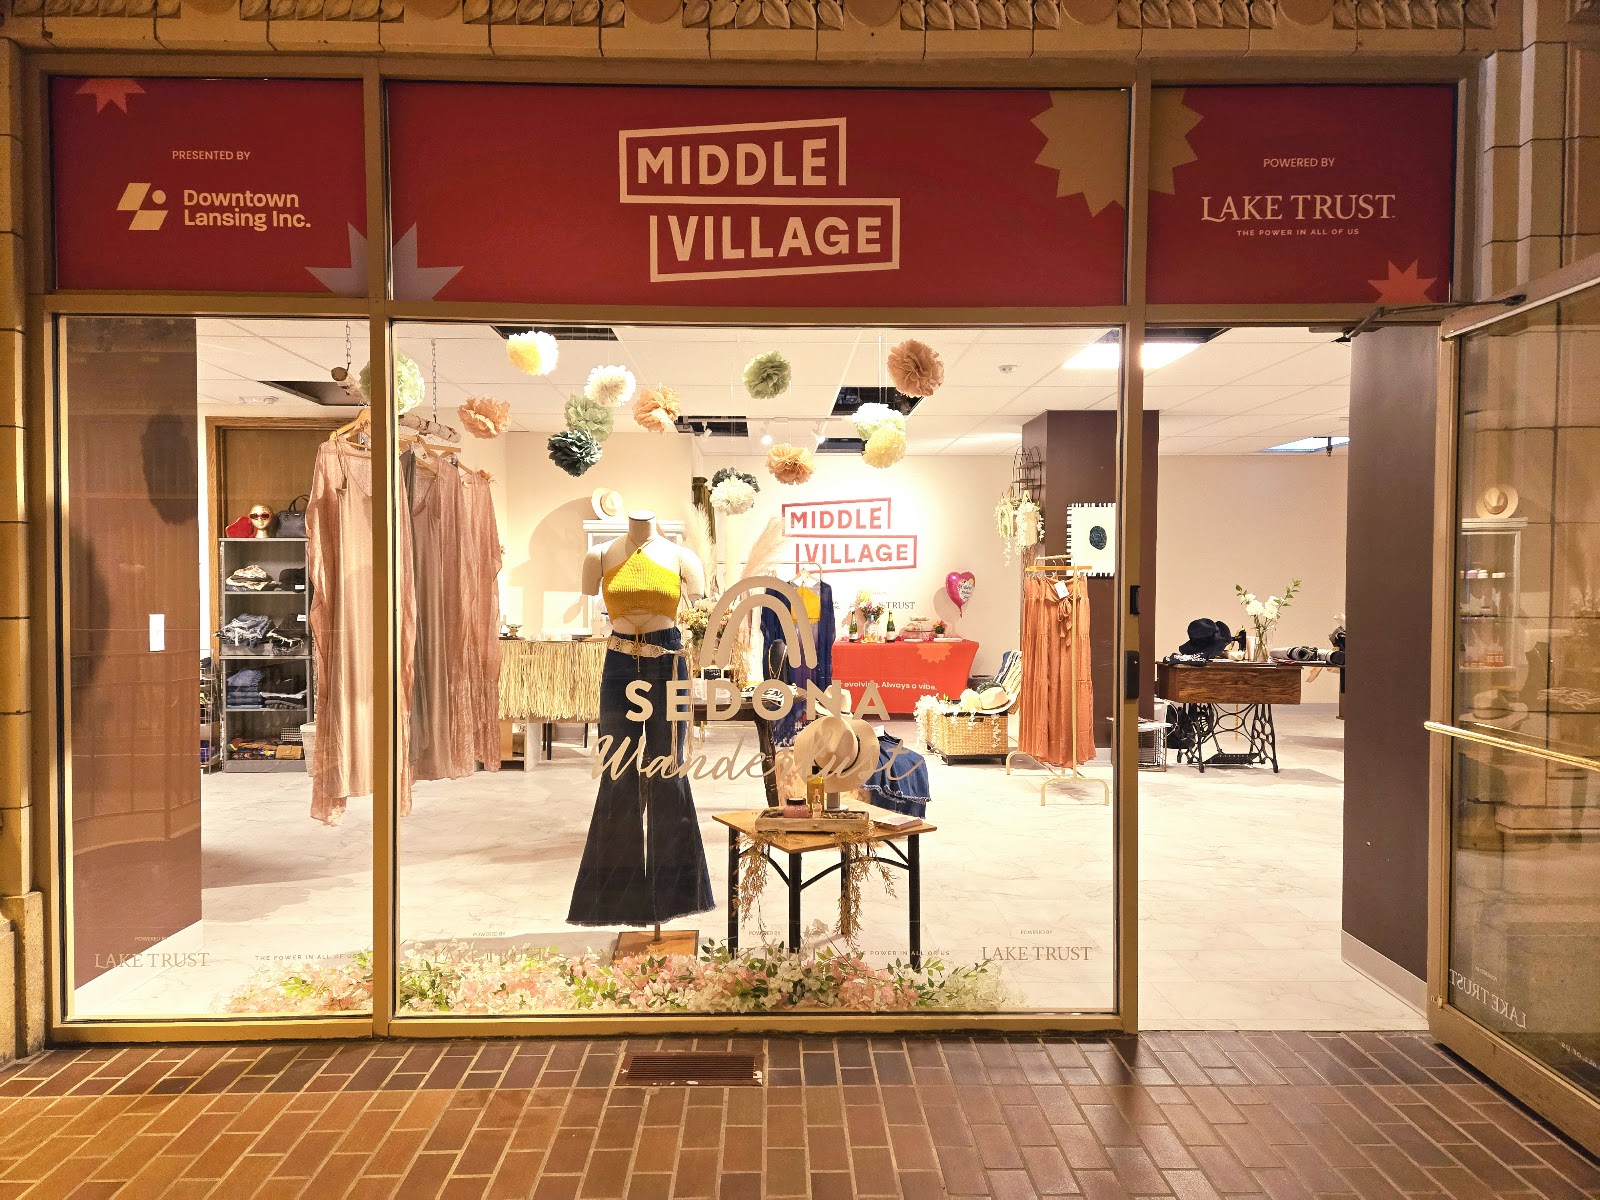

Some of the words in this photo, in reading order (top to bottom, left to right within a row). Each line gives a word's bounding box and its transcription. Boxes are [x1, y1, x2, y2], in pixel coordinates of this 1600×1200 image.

[172, 150, 234, 161] PRESENTED
[236, 150, 251, 161] BY
[637, 138, 827, 186] MIDDLE
[1263, 158, 1318, 168] POWERED
[1321, 157, 1335, 167] BY
[183, 189, 299, 208] Downtown
[1200, 195, 1283, 222] LAKE
[1290, 194, 1396, 219] TRUST
[184, 209, 267, 231] Lansing
[273, 211, 312, 228] Inc.
[667, 215, 882, 262] VILLAGE
[1236, 229, 1255, 237] THE
[790, 507, 882, 530] MIDDLE
[805, 543, 909, 564] VILLAGE
[885, 601, 916, 610] TRUST
[844, 680, 880, 689] evolvig.
[881, 681, 910, 690] Always
[918, 682, 938, 691] vibe.
[624, 679, 891, 722] SEDONA
[590, 731, 925, 782] Wanderlust
[94, 953, 143, 969] LAKE
[147, 952, 210, 968] TRUST
[981, 946, 1028, 961] LAKE
[1032, 946, 1093, 961] TRUST
